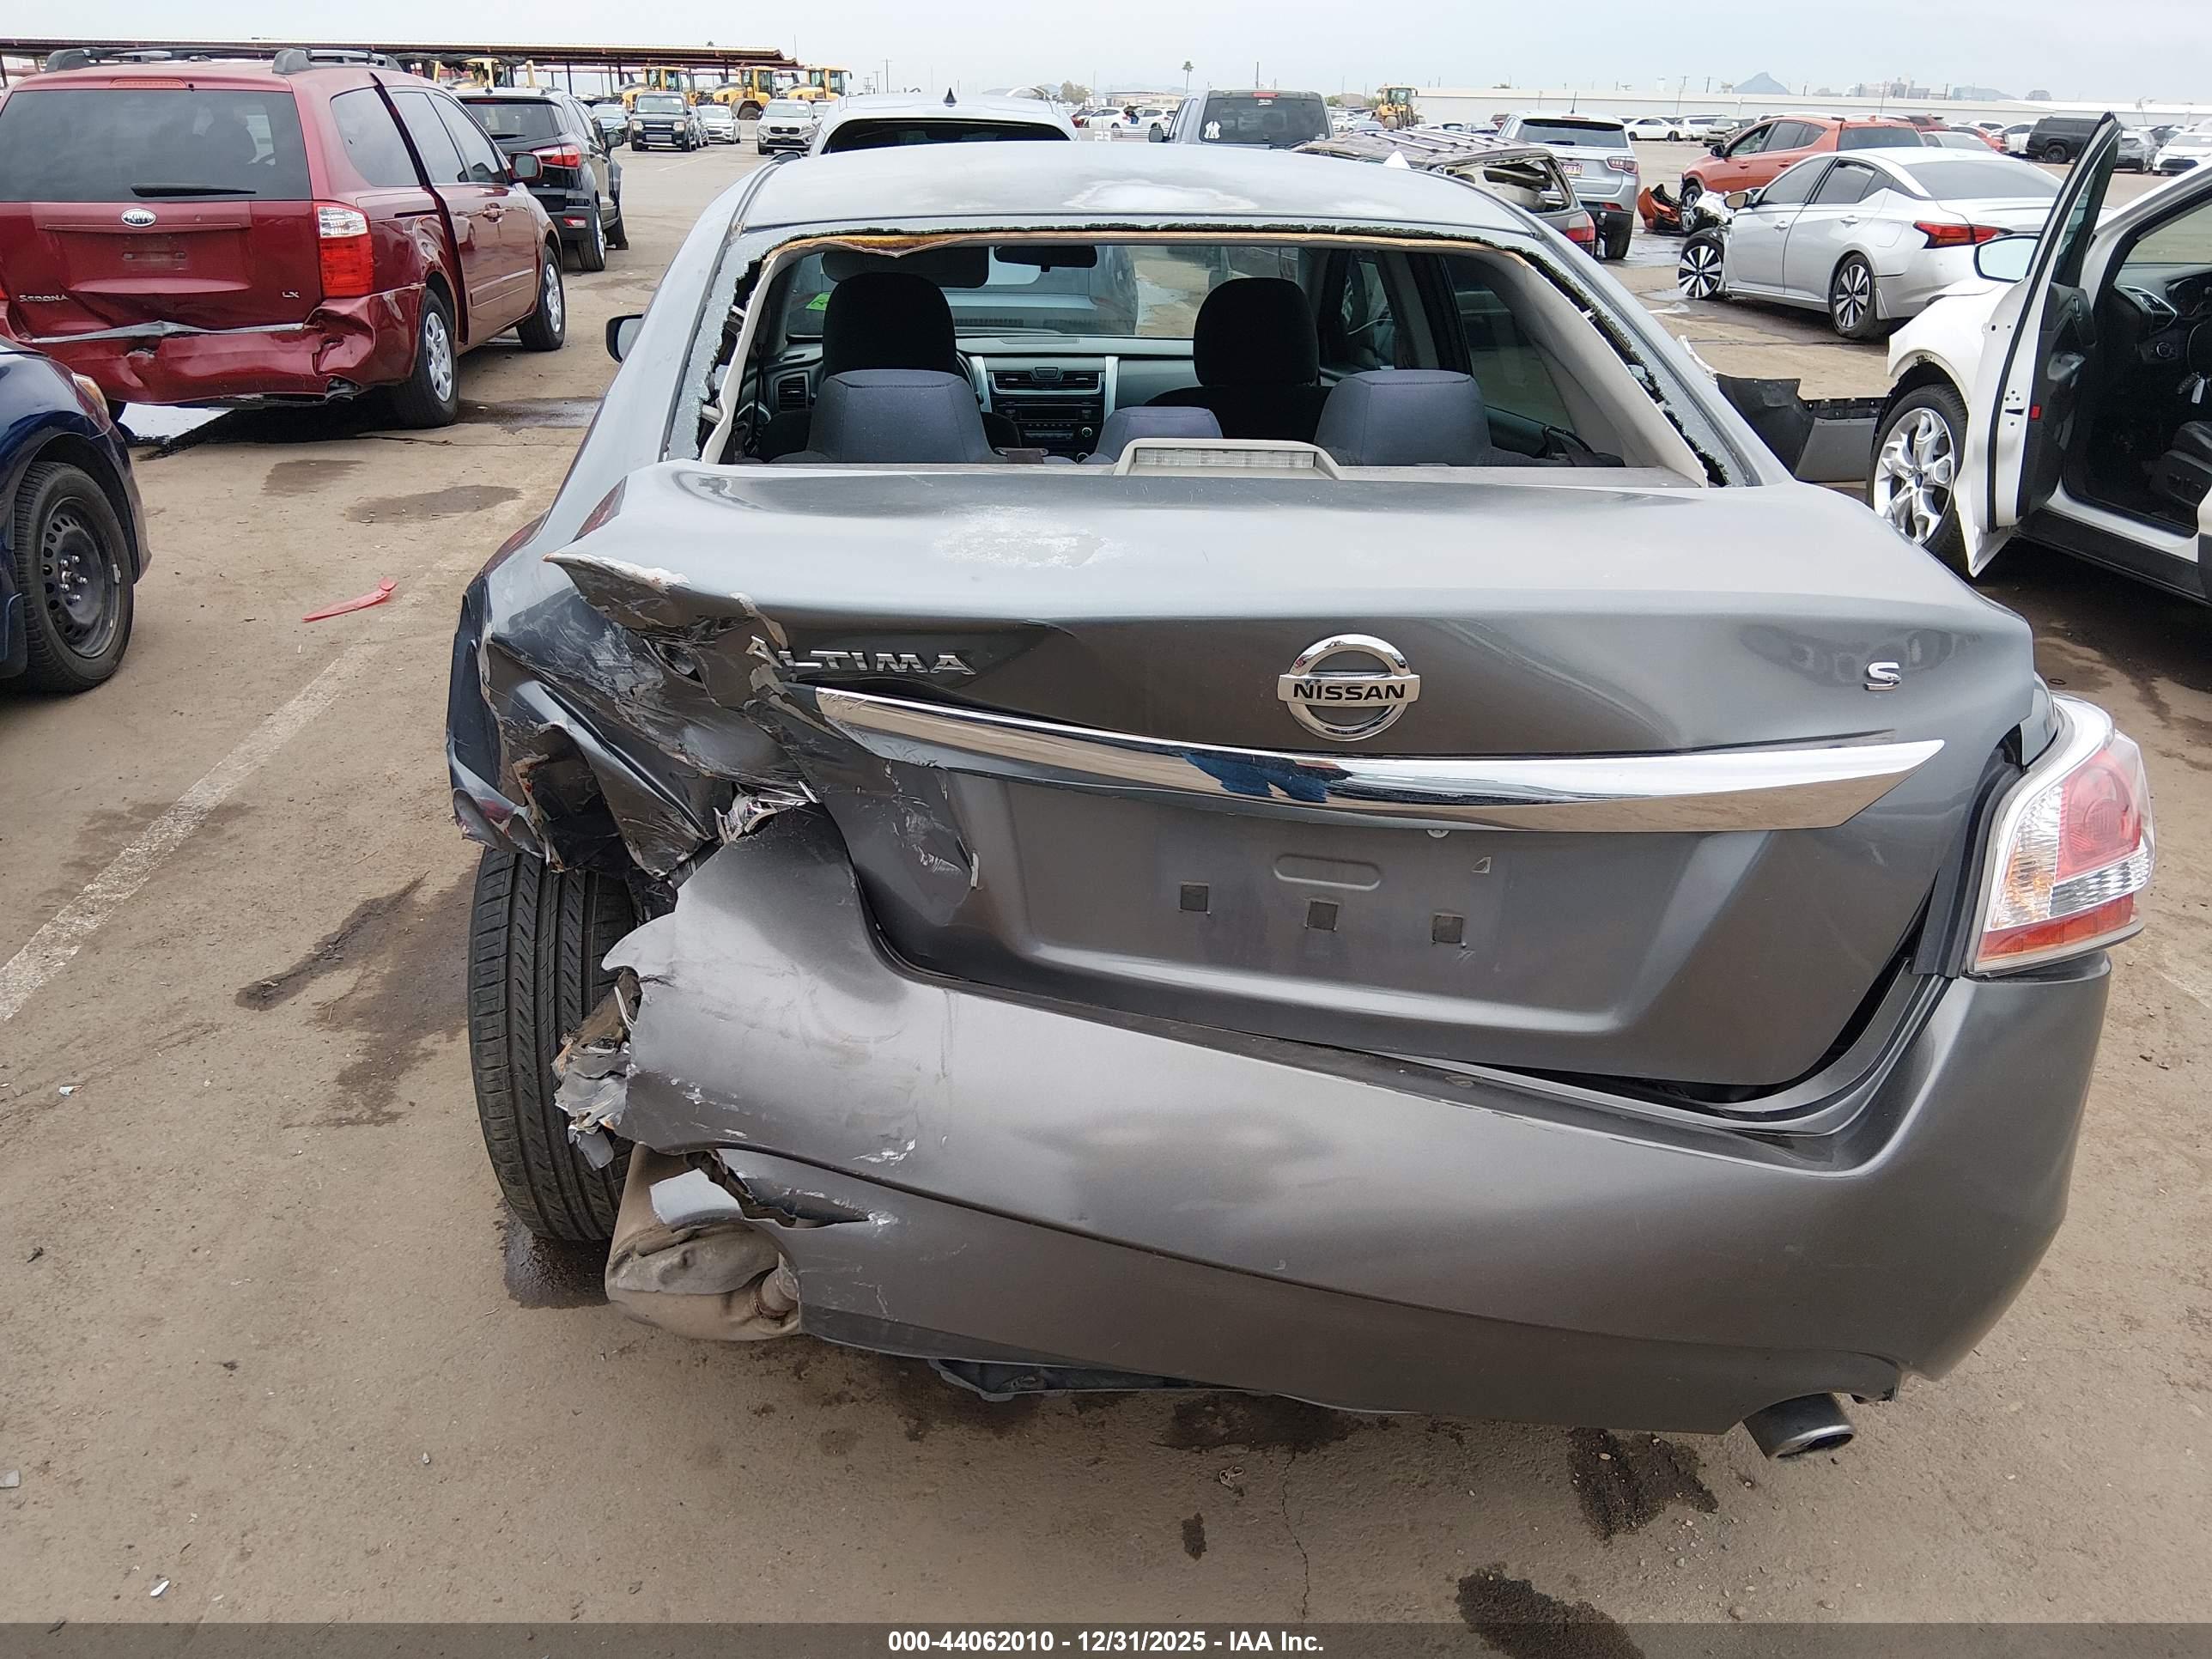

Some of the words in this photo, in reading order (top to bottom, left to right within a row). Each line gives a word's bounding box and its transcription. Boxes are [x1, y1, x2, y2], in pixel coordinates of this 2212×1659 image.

[745, 635, 976, 676] ALTIMA
[1866, 661, 1901, 691] S
[1293, 684, 1406, 701] NISSAN
